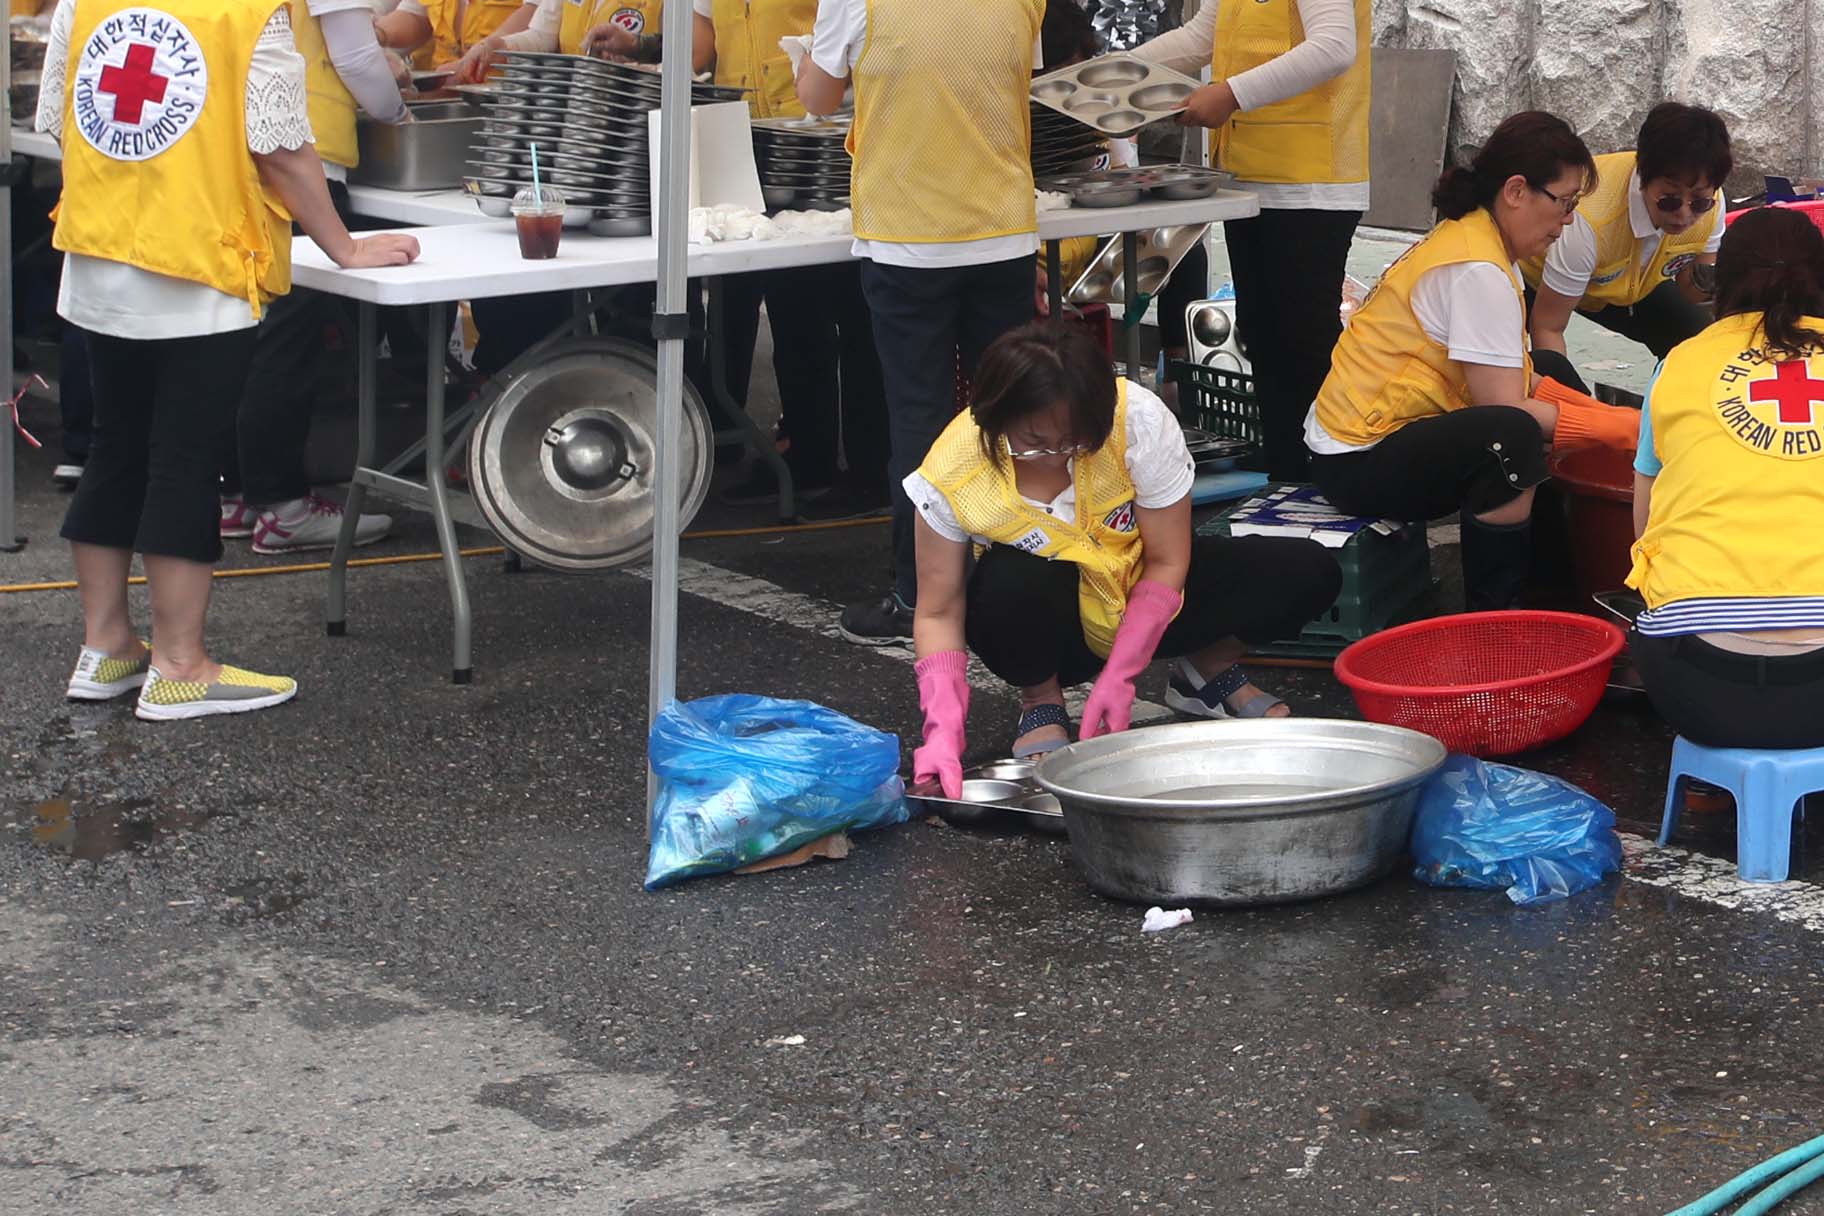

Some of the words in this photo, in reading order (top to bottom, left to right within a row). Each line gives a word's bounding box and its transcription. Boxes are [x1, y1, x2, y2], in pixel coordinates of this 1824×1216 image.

[87, 13, 200, 78] 대한적십자사
[76, 77, 109, 144] KOREAN
[109, 130, 143, 155] RED
[146, 98, 195, 151] CROSS
[1716, 396, 1777, 450] KOREAN
[1782, 429, 1822, 455] RED
